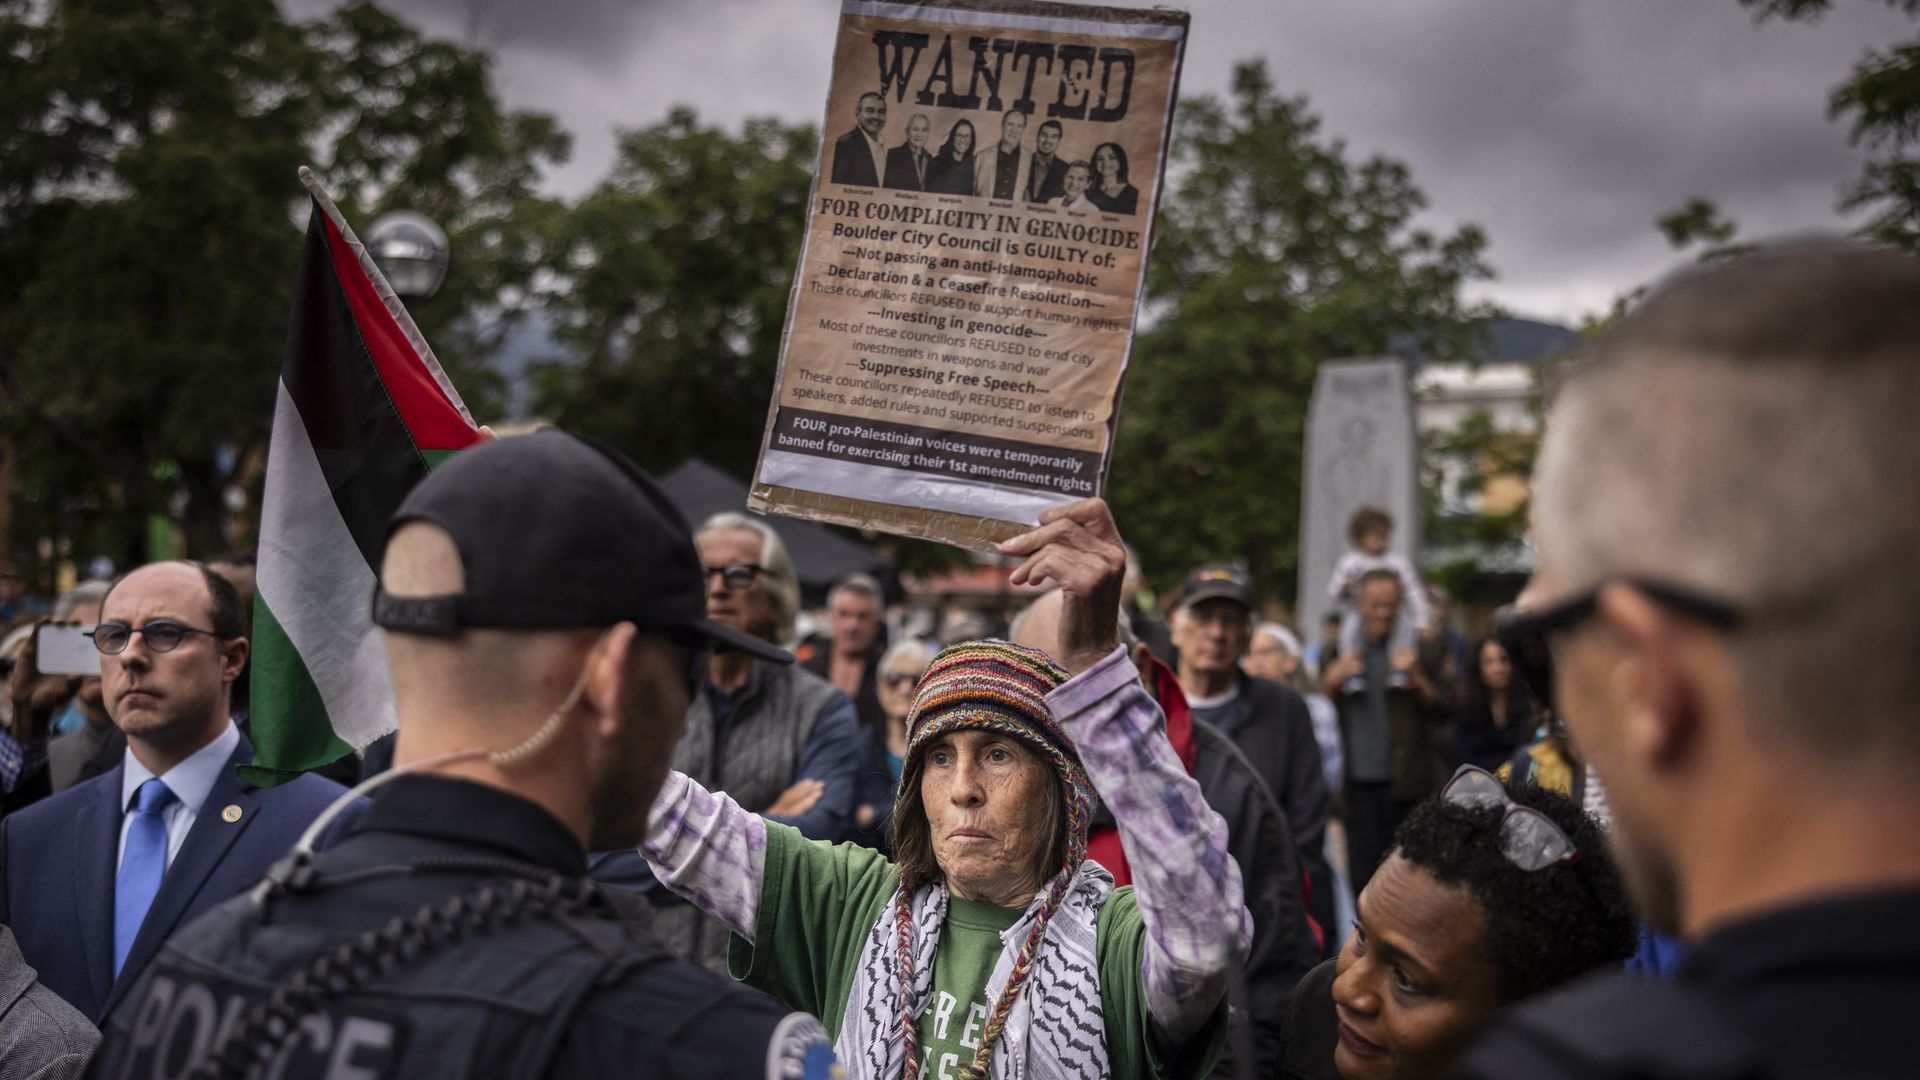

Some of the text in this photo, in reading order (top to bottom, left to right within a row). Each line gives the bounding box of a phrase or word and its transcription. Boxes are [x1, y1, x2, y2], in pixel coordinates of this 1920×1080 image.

[873, 31, 1135, 122] WANTED
[820, 199, 1139, 250] FOR COMPLICITY IN GENOCIDE
[833, 223, 1115, 268] Boulder City Council is GUILTY of:
[828, 265, 908, 284] Declaration
[912, 274, 921, 286] &
[926, 278, 934, 287] a
[939, 278, 1007, 297] Ceasefire
[884, 253, 936, 269] passing
[941, 259, 959, 268] an
[811, 281, 1122, 330] These councillors REFUSED to support human rights
[950, 316, 963, 329] in
[820, 319, 1094, 368] Most of these councillors REFUSED to end city
[852, 341, 1050, 376] investments in weapons and war
[800, 369, 1095, 421] These councillors repeatedly REFUSED to listen to
[948, 371, 979, 386] Free
[792, 388, 1094, 439] speakers, added rules and supported suspensions
[779, 433, 1092, 491] banned for exercising their 1st amendment rights
[794, 418, 1083, 473] FOUR pro-Palestinian voices were temporarily
